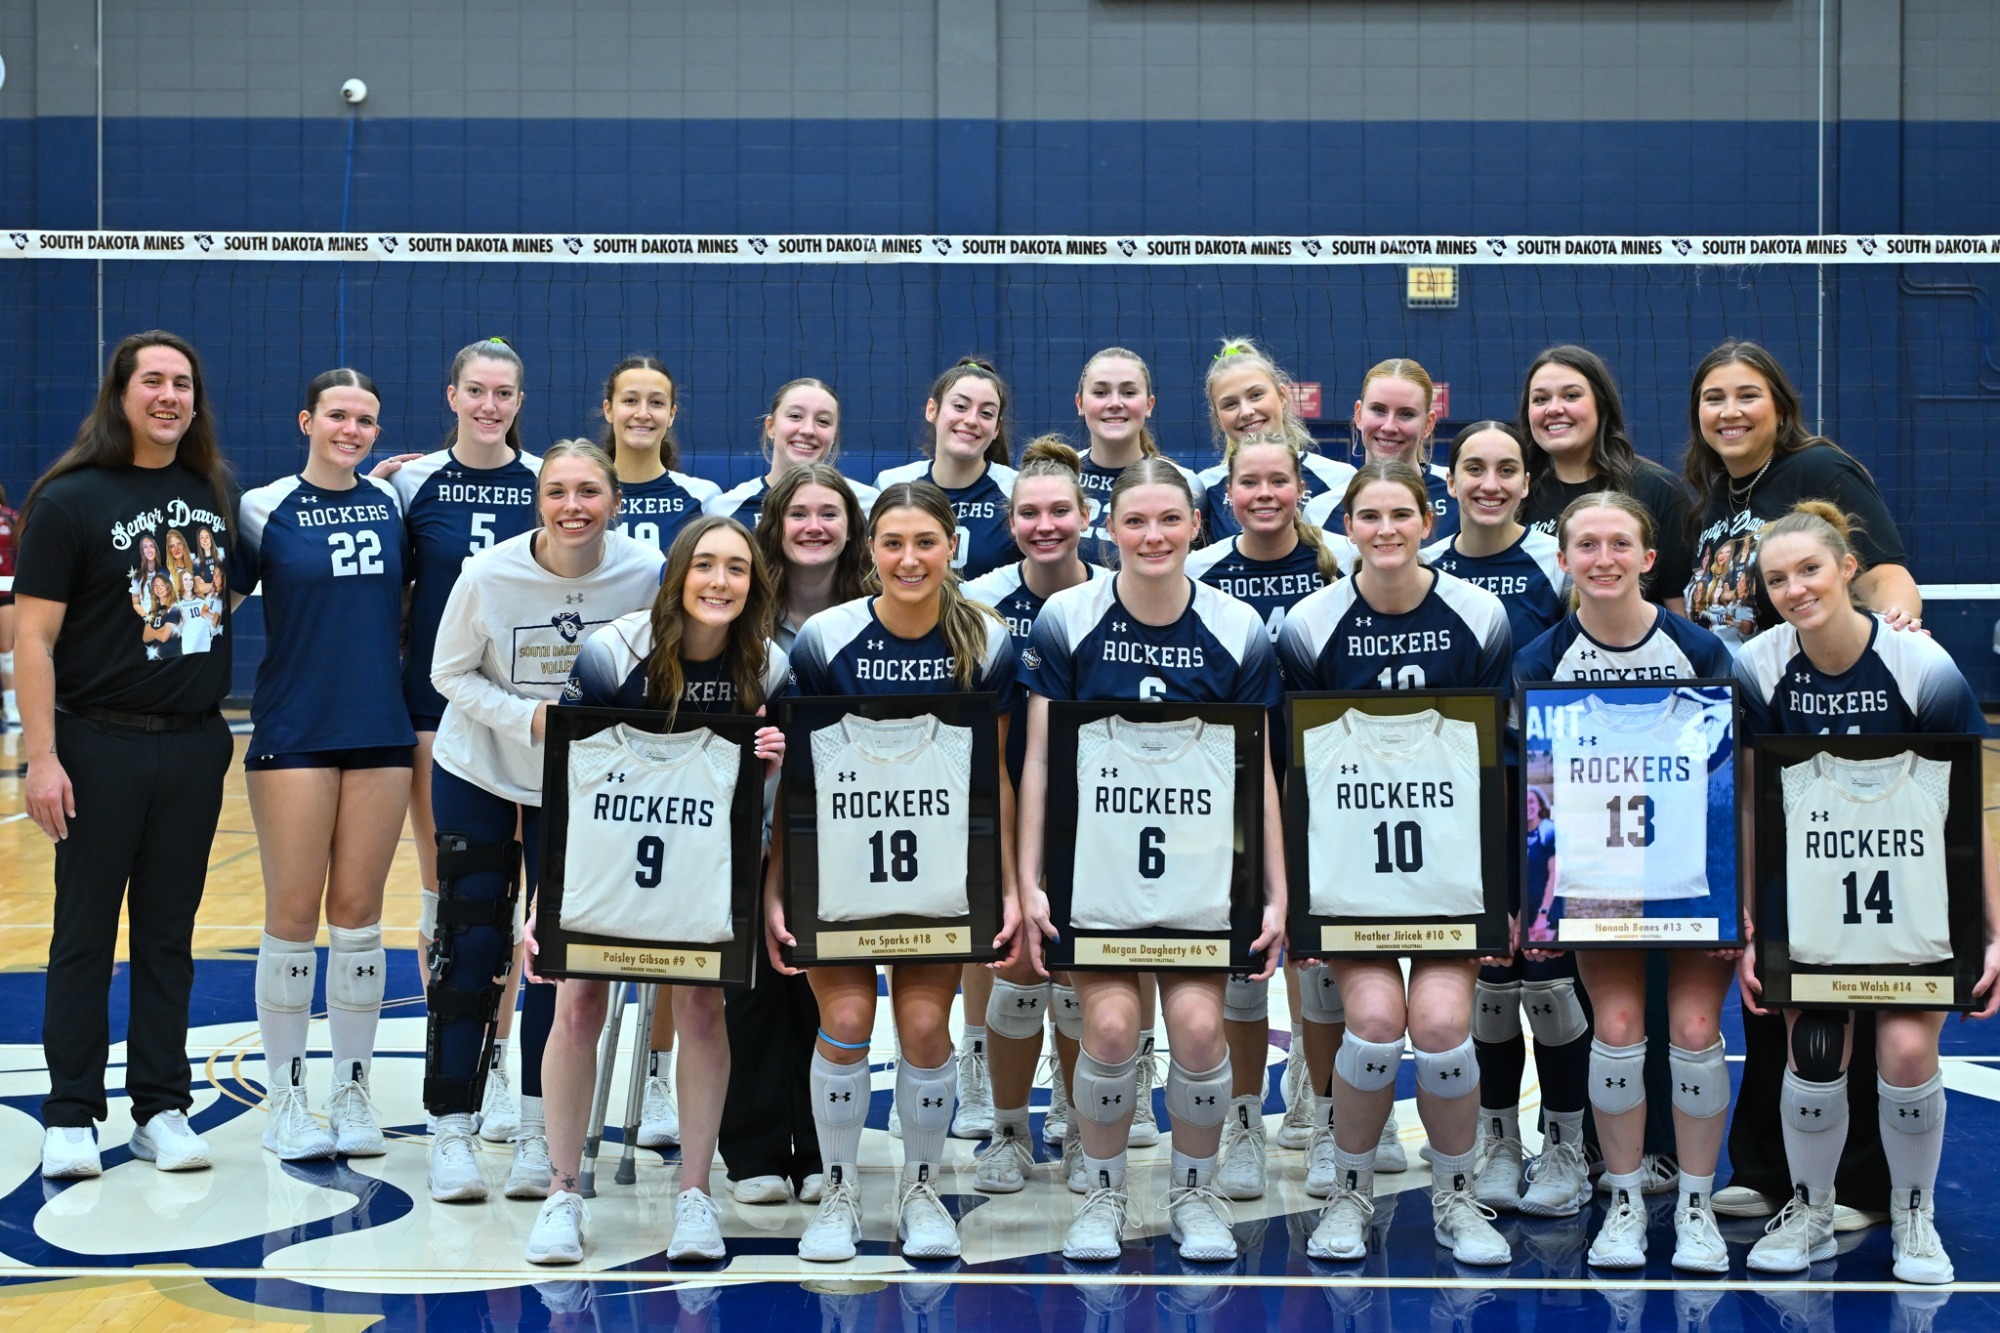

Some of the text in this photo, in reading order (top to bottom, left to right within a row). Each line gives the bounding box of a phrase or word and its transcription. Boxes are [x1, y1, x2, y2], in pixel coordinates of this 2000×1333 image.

[39, 234, 185, 251] SOUTH DAKOTA MINES
[224, 236, 369, 252] SOUTH DAKOTA MINES
[408, 237, 554, 253] SOUTH DAKOTA MINES
[593, 238, 739, 254] SOUTH DAKOTA MINES
[778, 237, 923, 254] SOUTH DAKOTA MINES
[962, 239, 1108, 255] SOUTH DAKOTA MINES
[1147, 240, 1292, 256] SOUTH DAKOTA MINES
[1332, 239, 1478, 256] SOUTH DAKOTA MINES
[1517, 239, 1663, 255] SOUTH DAKOTA MINES
[1702, 239, 1847, 255] SOUTH DAKOTA MINES
[1887, 239, 1931, 254] SOUTH
[1935, 238, 1988, 254] DAKOTA
[1416, 272, 1447, 293] EXIT
[438, 484, 532, 505] ROCKERS
[296, 504, 390, 527] ROCKERS
[618, 497, 684, 514] CKERS
[111, 498, 226, 550] Senior Dawgs
[328, 529, 384, 577] 22
[1219, 572, 1325, 597] ROCKERS
[552, 644, 584, 656] DAKO
[1347, 629, 1451, 657] ROCKERS
[1102, 640, 1204, 668] ROCKERS
[856, 656, 956, 681] ROCKERS
[1789, 690, 1888, 715] ROCKERS
[1570, 756, 1690, 784] ROCKERS
[832, 789, 950, 819] ROCKERS
[1095, 786, 1212, 815] ROCKERS
[1337, 781, 1454, 810] ROCKERS
[593, 793, 714, 827] ROCKERS
[1606, 795, 1655, 848] 13
[1138, 826, 1166, 879] 6
[1373, 820, 1423, 873] 10
[1806, 829, 1925, 858] ROCKERS
[635, 835, 665, 889] 9
[868, 829, 918, 883] 18
[1842, 870, 1893, 924] 14
[1354, 930, 1444, 941] Heather Jiricek #10
[1595, 923, 1682, 932] Hannah Benes #13
[858, 934, 931, 947] Ava Sparks #18
[1102, 943, 1202, 957] Morgan Daugherty #6
[603, 951, 685, 966] Paisley Gibson #9
[1832, 981, 1912, 992] Kiera Walsh #14
